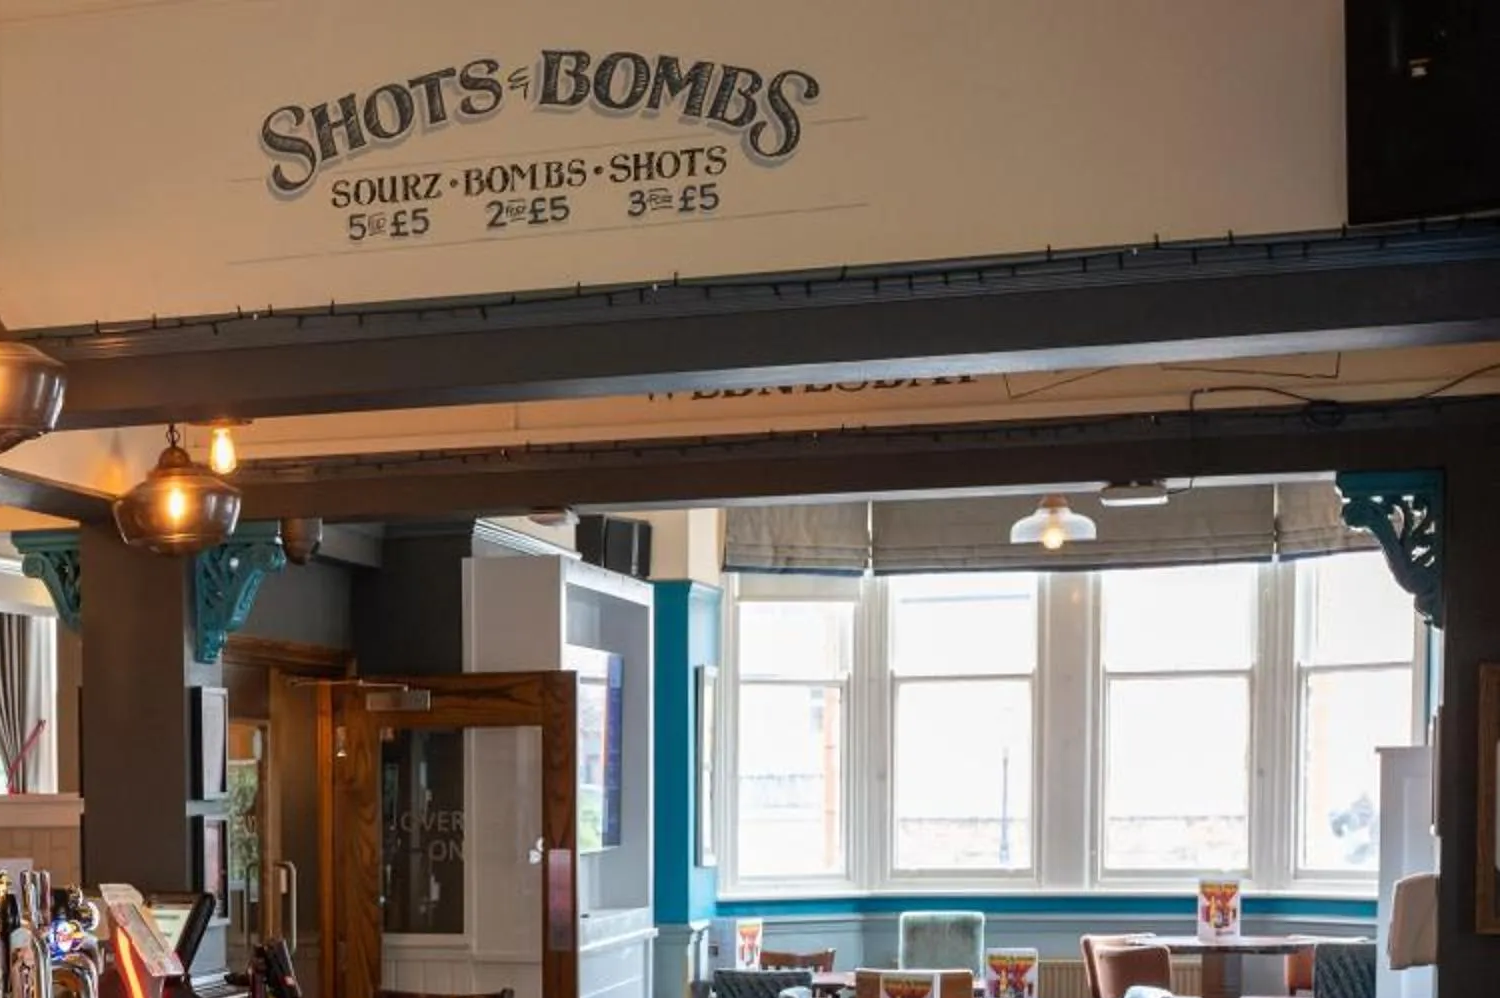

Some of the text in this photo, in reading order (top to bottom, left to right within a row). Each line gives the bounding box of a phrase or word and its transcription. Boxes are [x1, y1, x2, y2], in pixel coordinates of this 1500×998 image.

[261, 58, 503, 192] SHOTS
[540, 48, 820, 158] BOMBS
[331, 145, 728, 208] SOURZ BOMBS SHOTS
